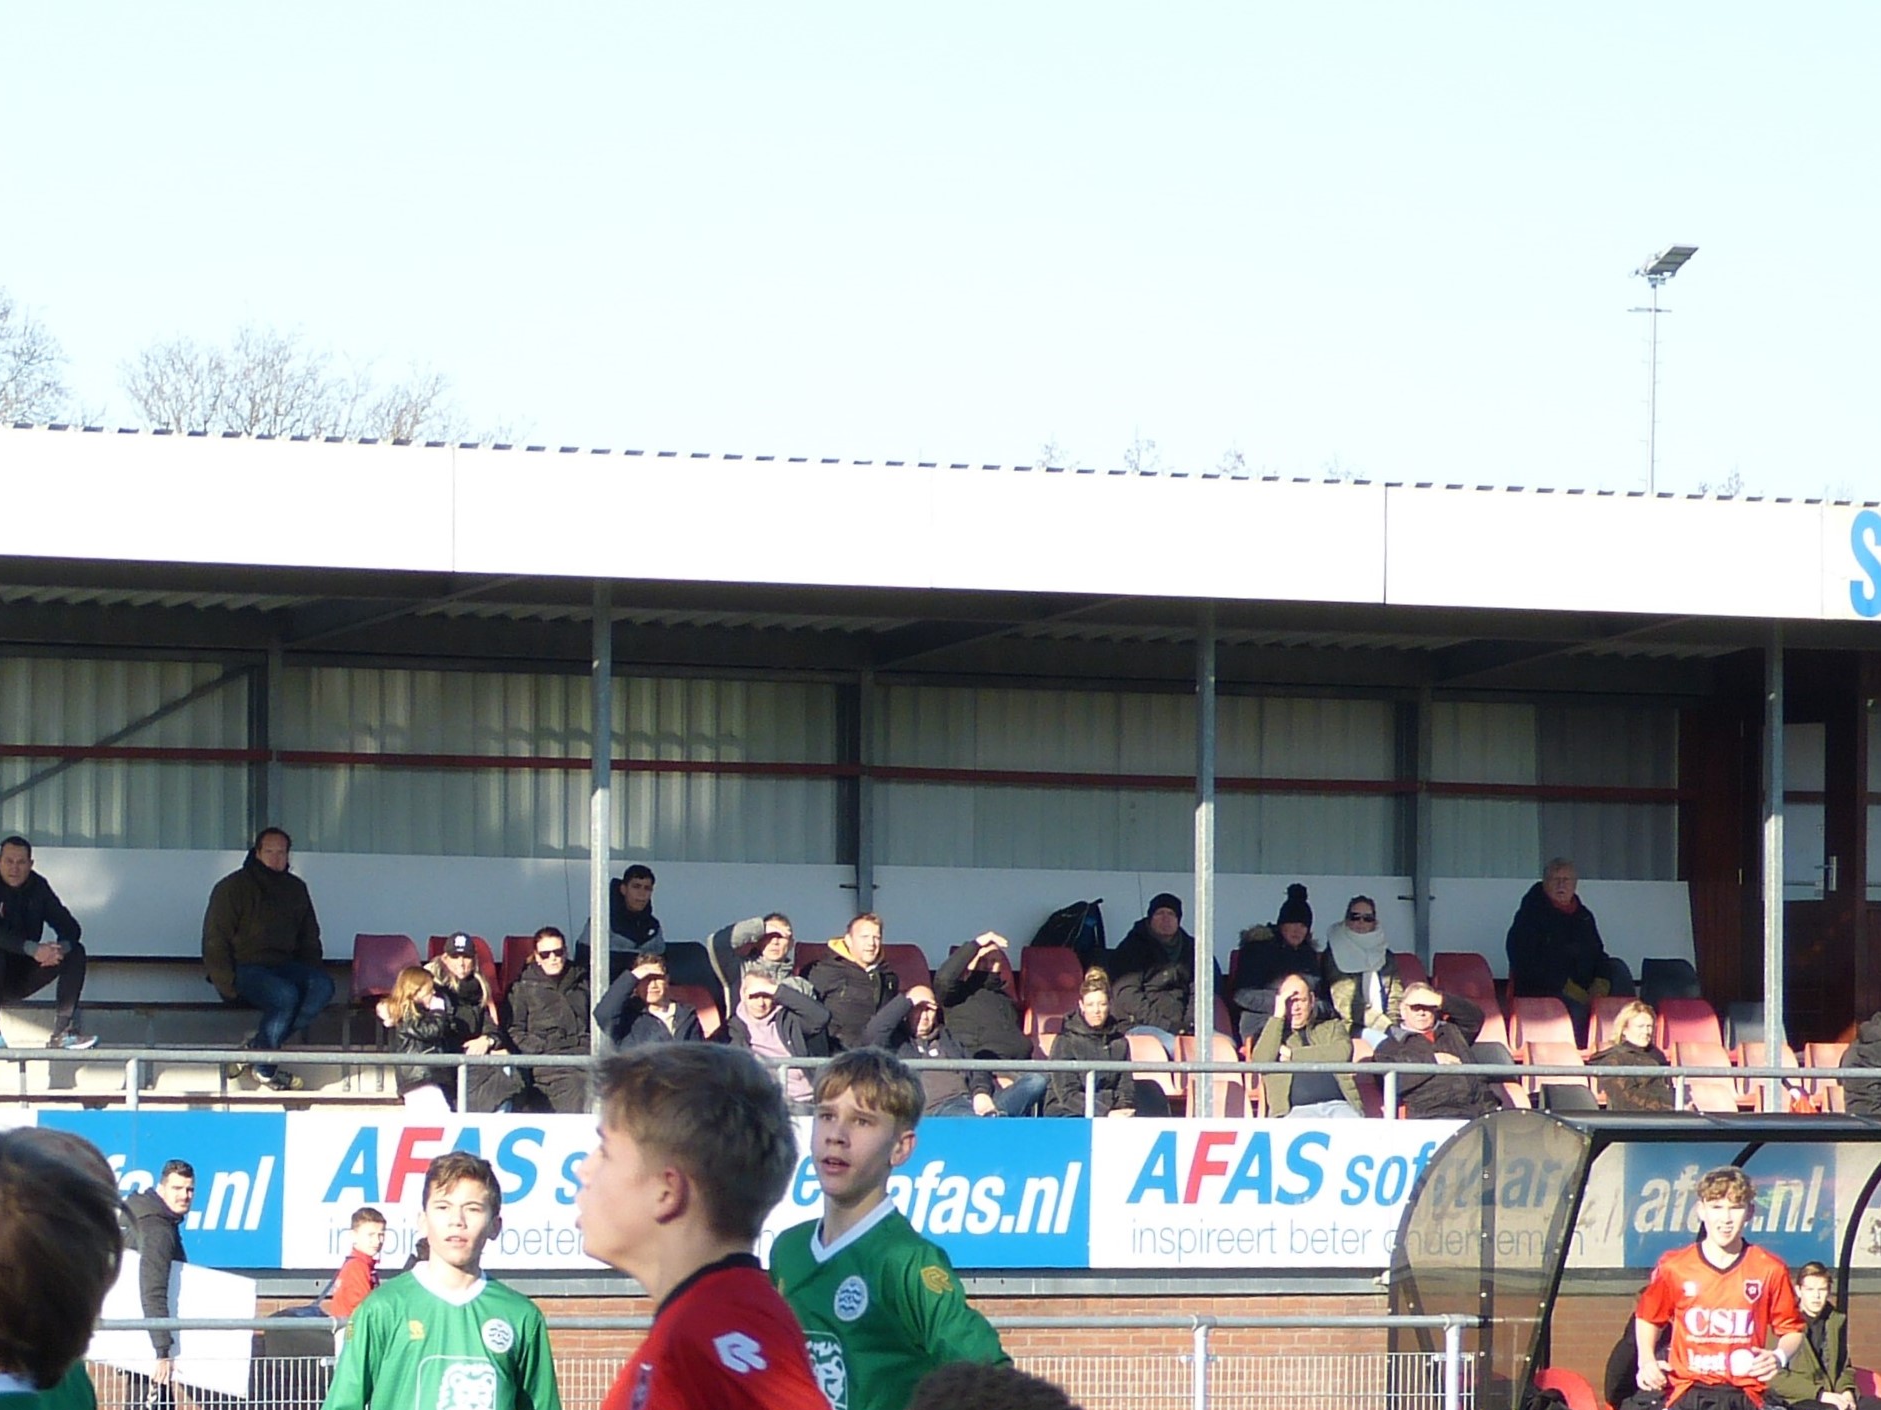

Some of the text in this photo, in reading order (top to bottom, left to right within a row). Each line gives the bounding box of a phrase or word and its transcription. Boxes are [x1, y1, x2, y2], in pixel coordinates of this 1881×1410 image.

[886, 1160, 1082, 1234] afas.nl
[1126, 1131, 1331, 1205] AFAS
[1633, 1164, 1825, 1233] af.nl
[1131, 1218, 1277, 1264] inspireert
[1289, 1219, 1372, 1255] beter
